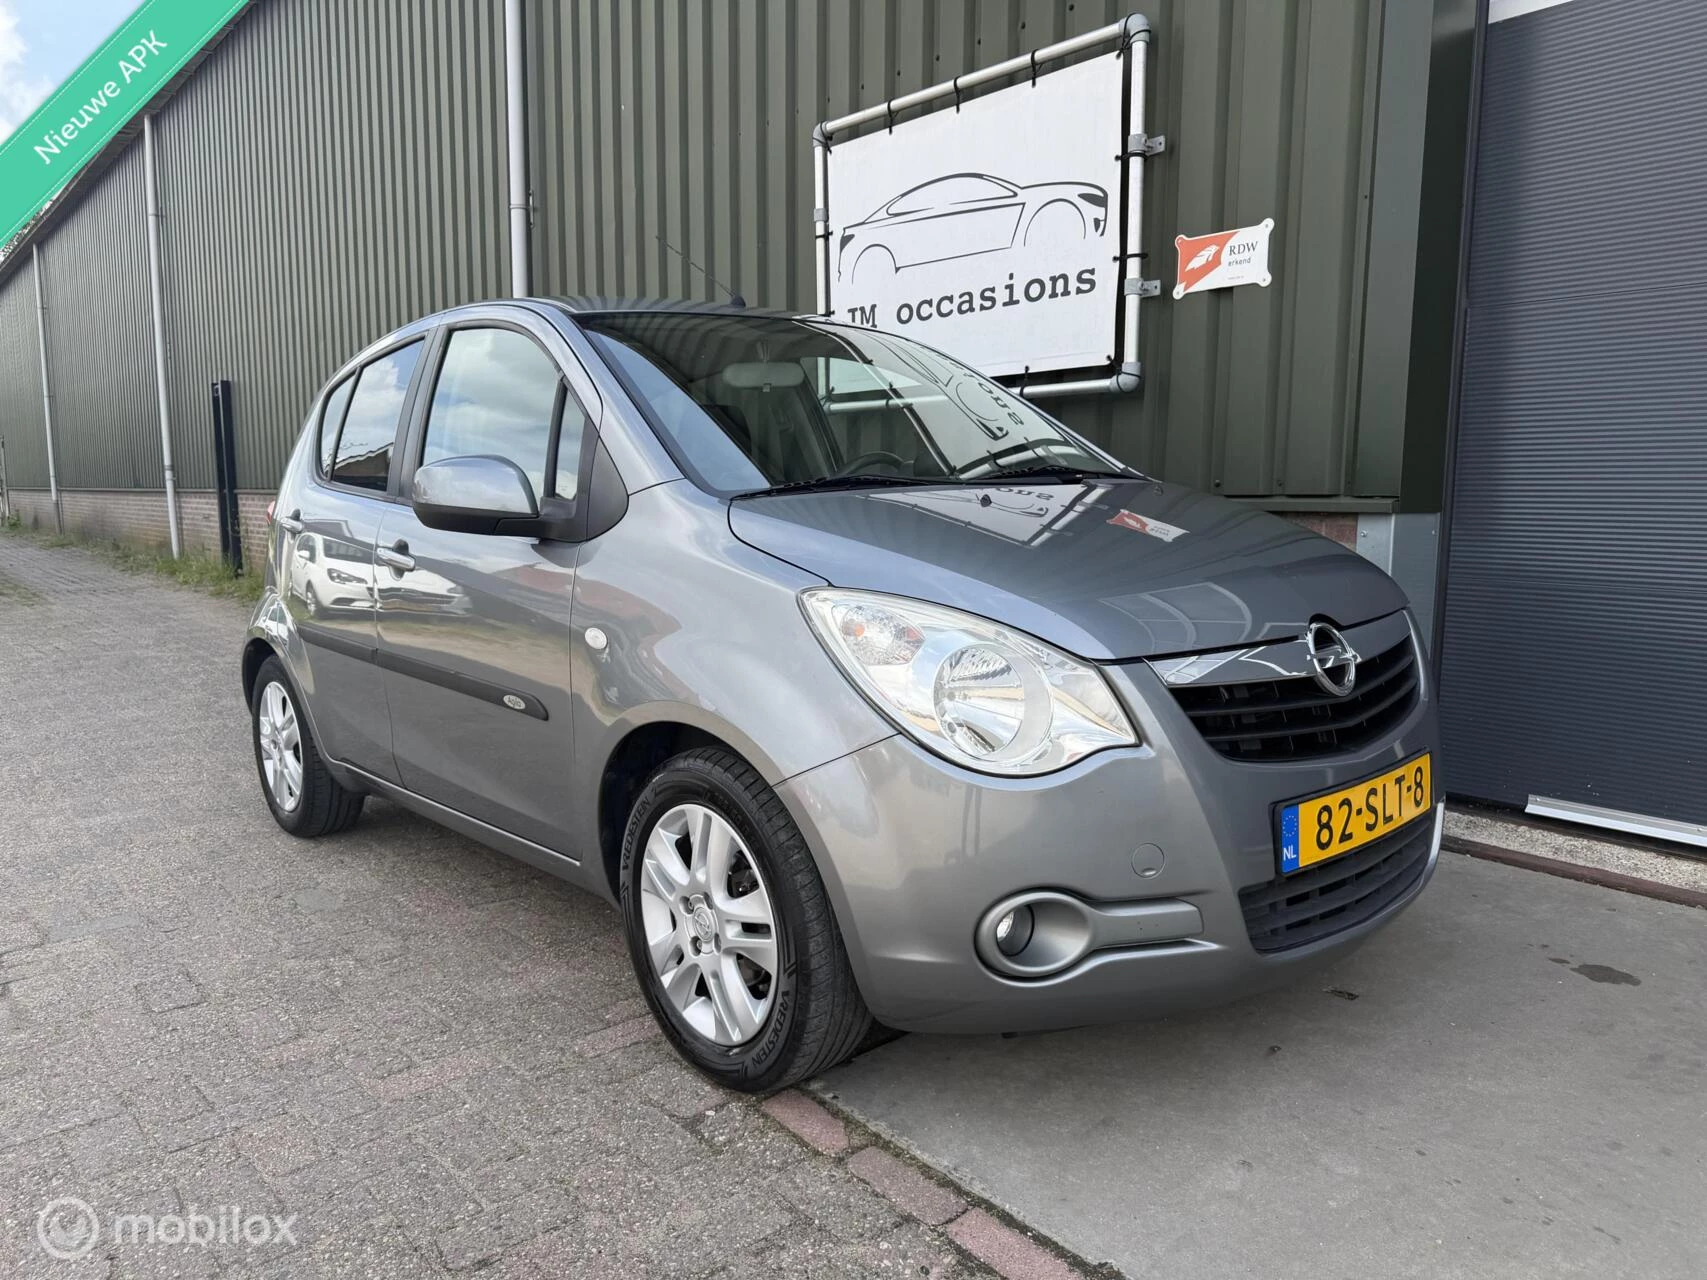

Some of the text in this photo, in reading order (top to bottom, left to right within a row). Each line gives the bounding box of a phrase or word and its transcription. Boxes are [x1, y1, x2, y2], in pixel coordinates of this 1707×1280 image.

[1229, 241, 1258, 256] RDW
[1228, 257, 1251, 267] erkend
[896, 267, 1097, 325] occasions
[1315, 766, 1424, 851] 82-SLT-8
[1283, 845, 1297, 861] NL
